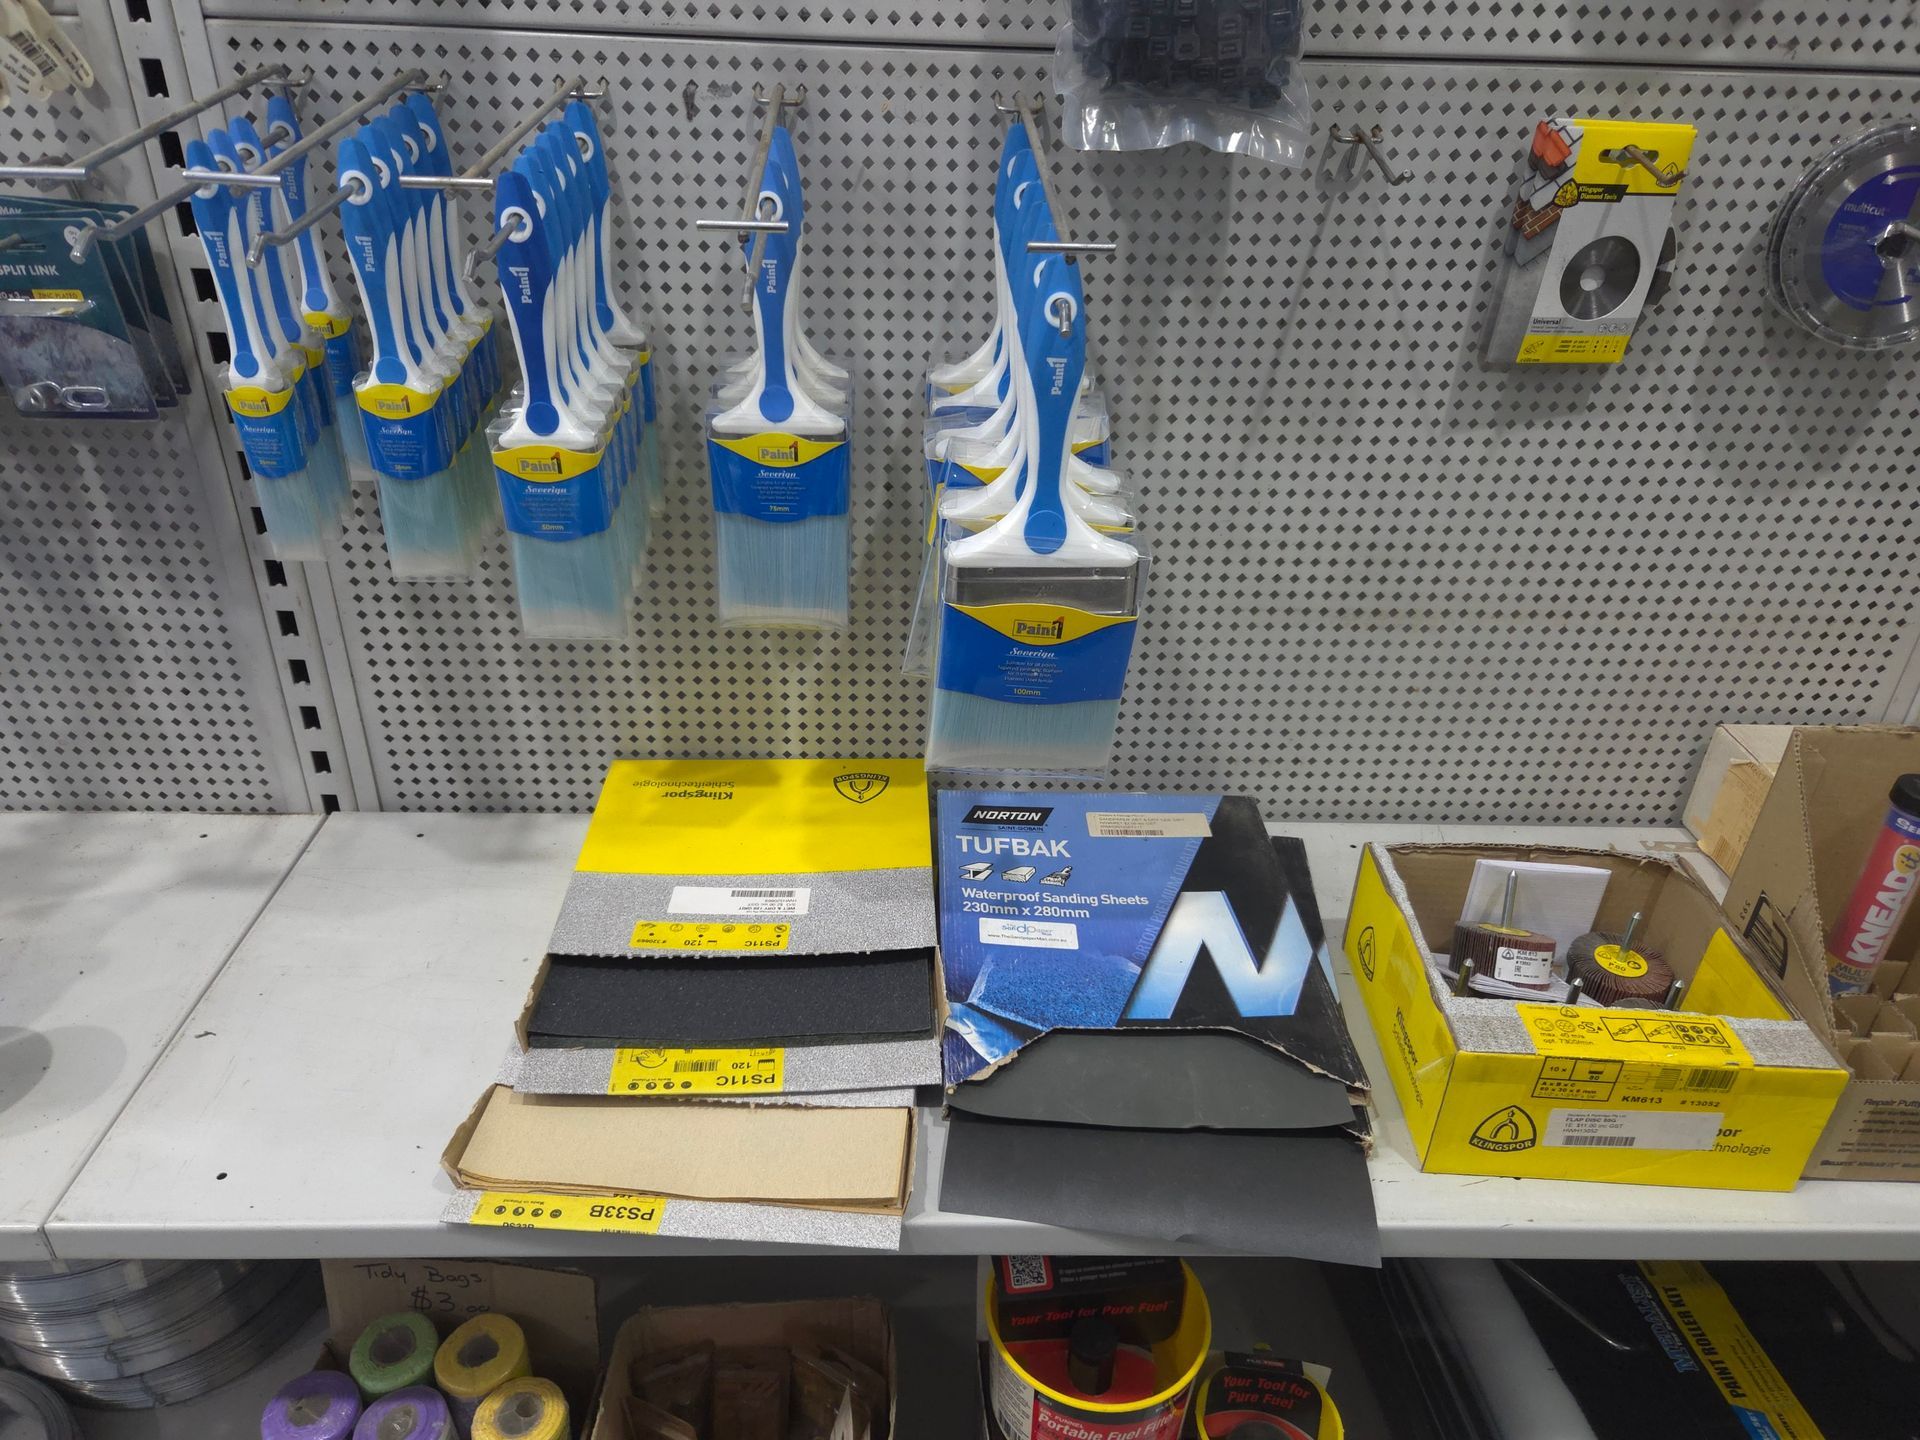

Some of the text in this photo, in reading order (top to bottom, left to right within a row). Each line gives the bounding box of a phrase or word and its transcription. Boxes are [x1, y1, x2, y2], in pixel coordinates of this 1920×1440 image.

[1578, 186, 1604, 195] Klingspor
[1843, 202, 1886, 216] multicut
[28, 264, 60, 276] LINK
[1014, 688, 1041, 697] 100mm
[632, 780, 735, 789] Schleiftechnologie
[835, 773, 890, 782] KLINGSPOR
[661, 790, 734, 801] Klingspor
[973, 810, 1042, 821] NORTON
[955, 835, 1072, 858] TUFBAK
[961, 887, 1150, 907] Waterproof Sanding Sheets
[962, 901, 1090, 918] 230mm x 280mm
[1845, 867, 1916, 964] KNEAD
[716, 1073, 776, 1086] PS11C
[1620, 1095, 1663, 1104] KM613
[1471, 1136, 1533, 1152] KLINGSPOR
[589, 1204, 656, 1221] PS33B
[353, 1262, 406, 1284] Tidy
[1662, 1285, 1686, 1309] KIT
[1010, 1300, 1169, 1327] Your Tool for Pure Fuel
[1677, 1309, 1718, 1357] ROLLER
[1709, 1353, 1748, 1400] PAINT
[1223, 1374, 1313, 1400] Your Tool for
[1227, 1391, 1294, 1410] Pure Fuel
[1038, 1413, 1104, 1440] Portable
[1107, 1427, 1142, 1440] Fuel
[1054, 1415, 1085, 1429] FUNNEL
